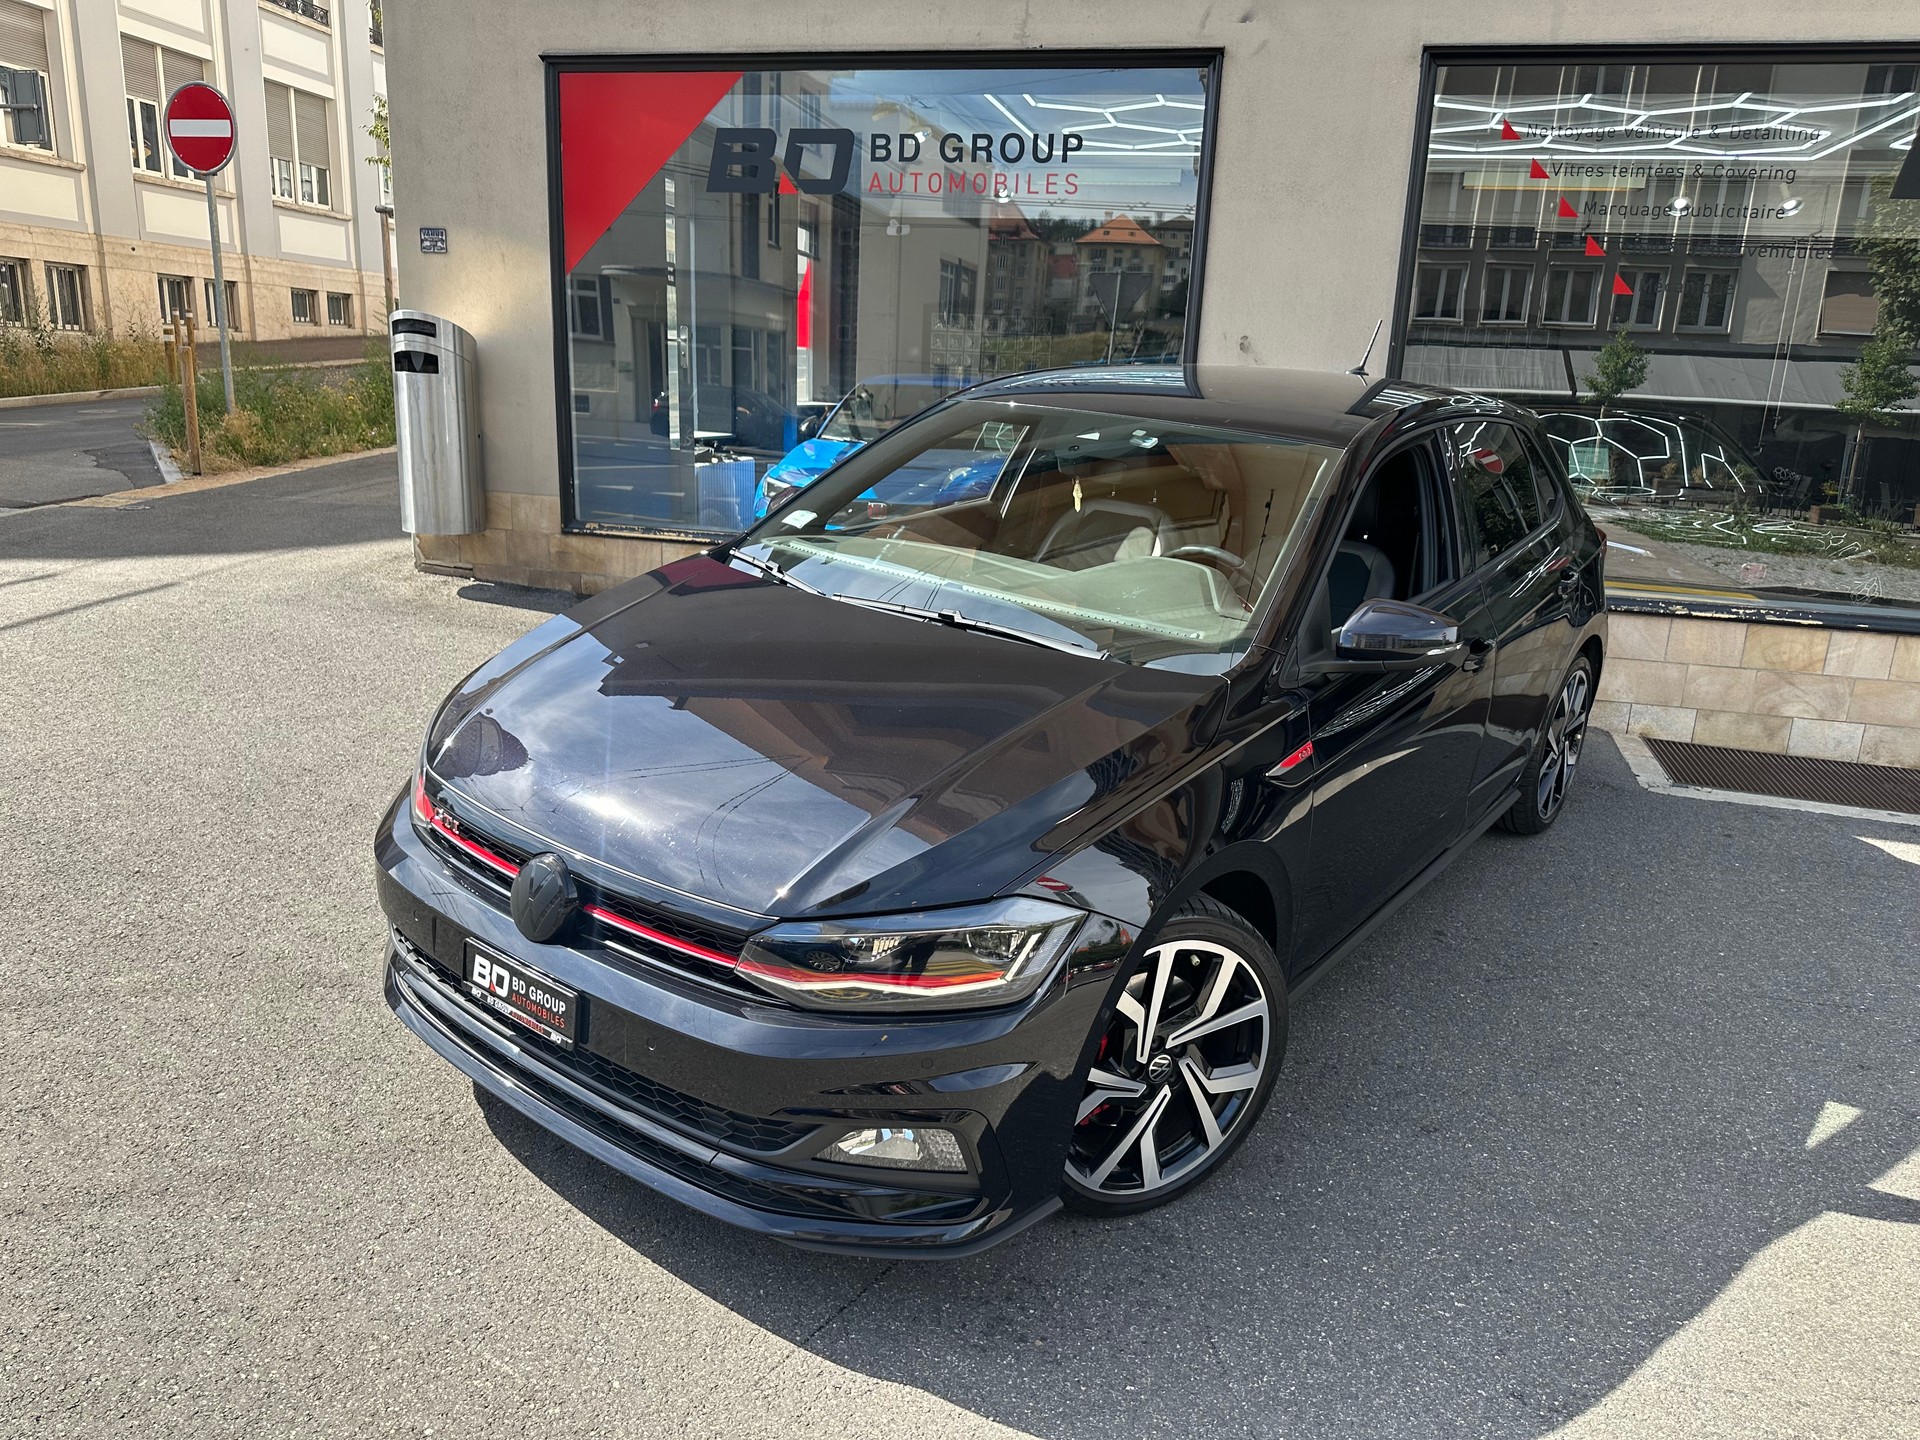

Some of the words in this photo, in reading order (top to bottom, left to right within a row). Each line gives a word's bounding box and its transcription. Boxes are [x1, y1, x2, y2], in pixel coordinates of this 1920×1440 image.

[1526, 124, 1616, 141] Nettoyage
[1624, 124, 1701, 139] véhicule
[1708, 125, 1720, 139] &
[870, 133, 921, 163] BD
[939, 132, 1084, 163] GROUP
[869, 172, 1080, 195] AUTOMOBILES
[1552, 162, 1604, 177] Vitres
[1612, 162, 1685, 178] teintées
[1692, 164, 1705, 178] &
[1713, 164, 1797, 184] Covering
[1583, 201, 1671, 220] Marquage
[1679, 204, 1786, 220] publicitaire
[512, 976, 526, 995] BD
[528, 985, 566, 1014] GROUP
[511, 993, 565, 1028] AUTOMOBILES
